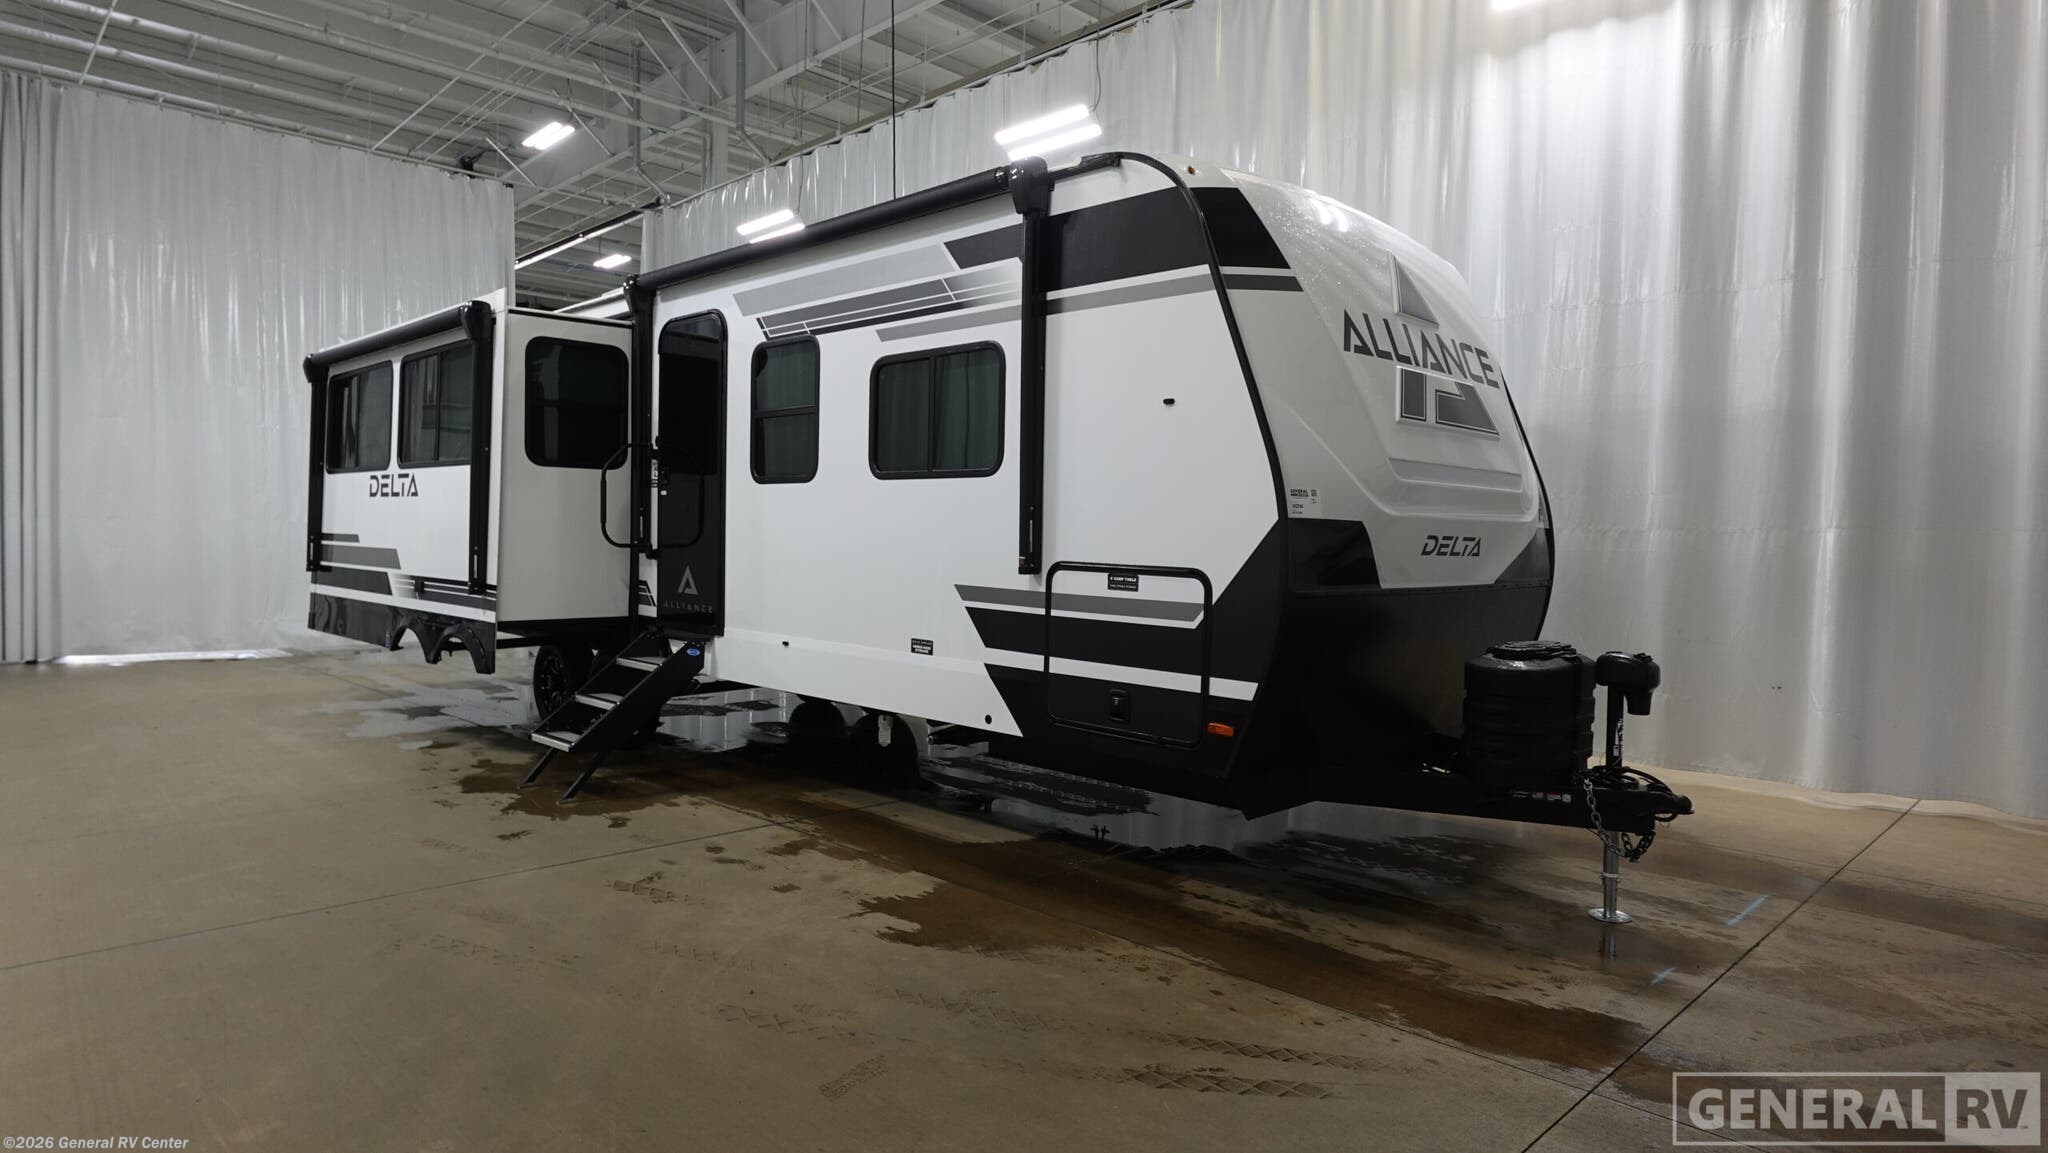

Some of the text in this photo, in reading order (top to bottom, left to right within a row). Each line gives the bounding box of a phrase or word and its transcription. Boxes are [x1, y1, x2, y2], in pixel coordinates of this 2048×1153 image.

[1343, 309, 1500, 389] ALLIANCE
[369, 473, 419, 497] DELTA
[1421, 534, 1481, 557] DELTA
[663, 600, 713, 614] ALLIANCE
